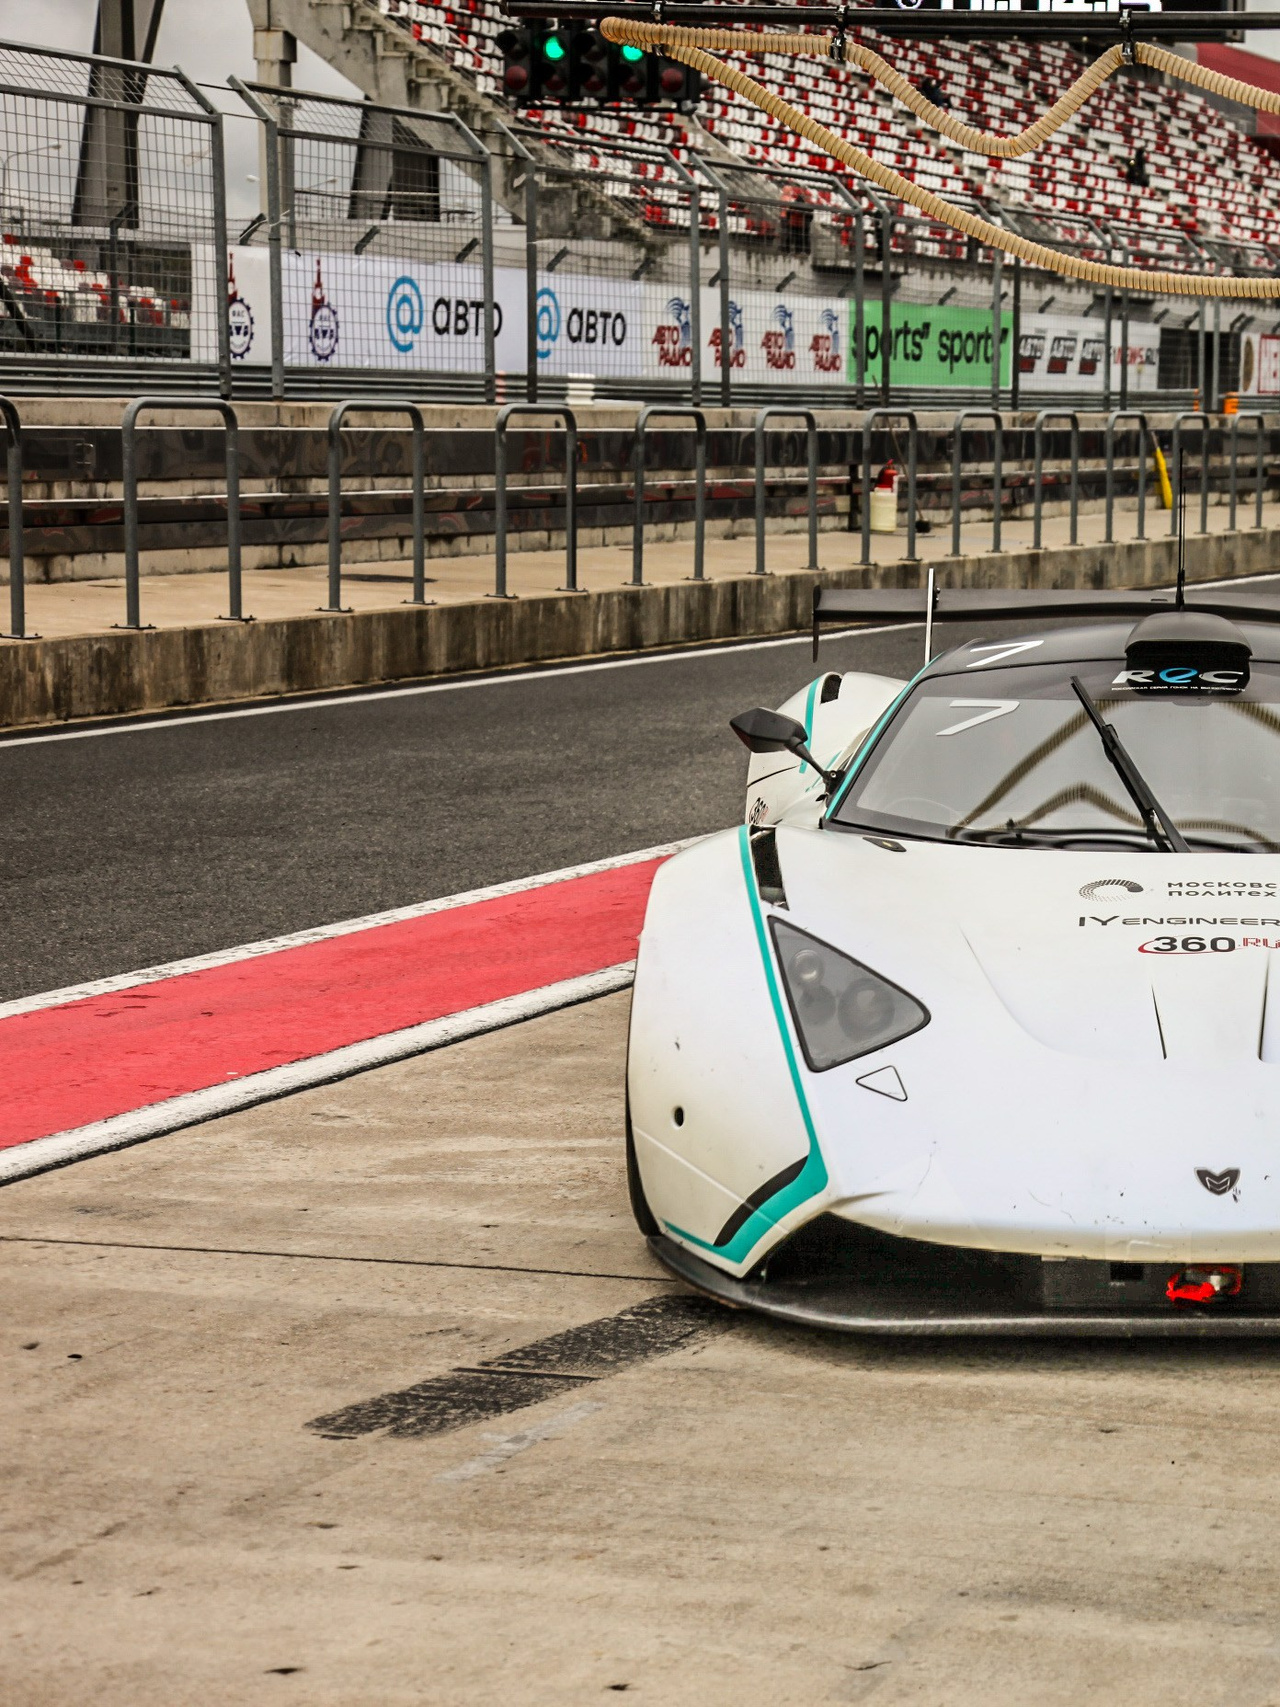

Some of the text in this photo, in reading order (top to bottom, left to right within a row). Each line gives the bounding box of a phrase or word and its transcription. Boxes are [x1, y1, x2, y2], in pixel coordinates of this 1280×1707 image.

[567, 307, 627, 346] авто
[966, 640, 1045, 668] 7
[936, 700, 1020, 736] 7
